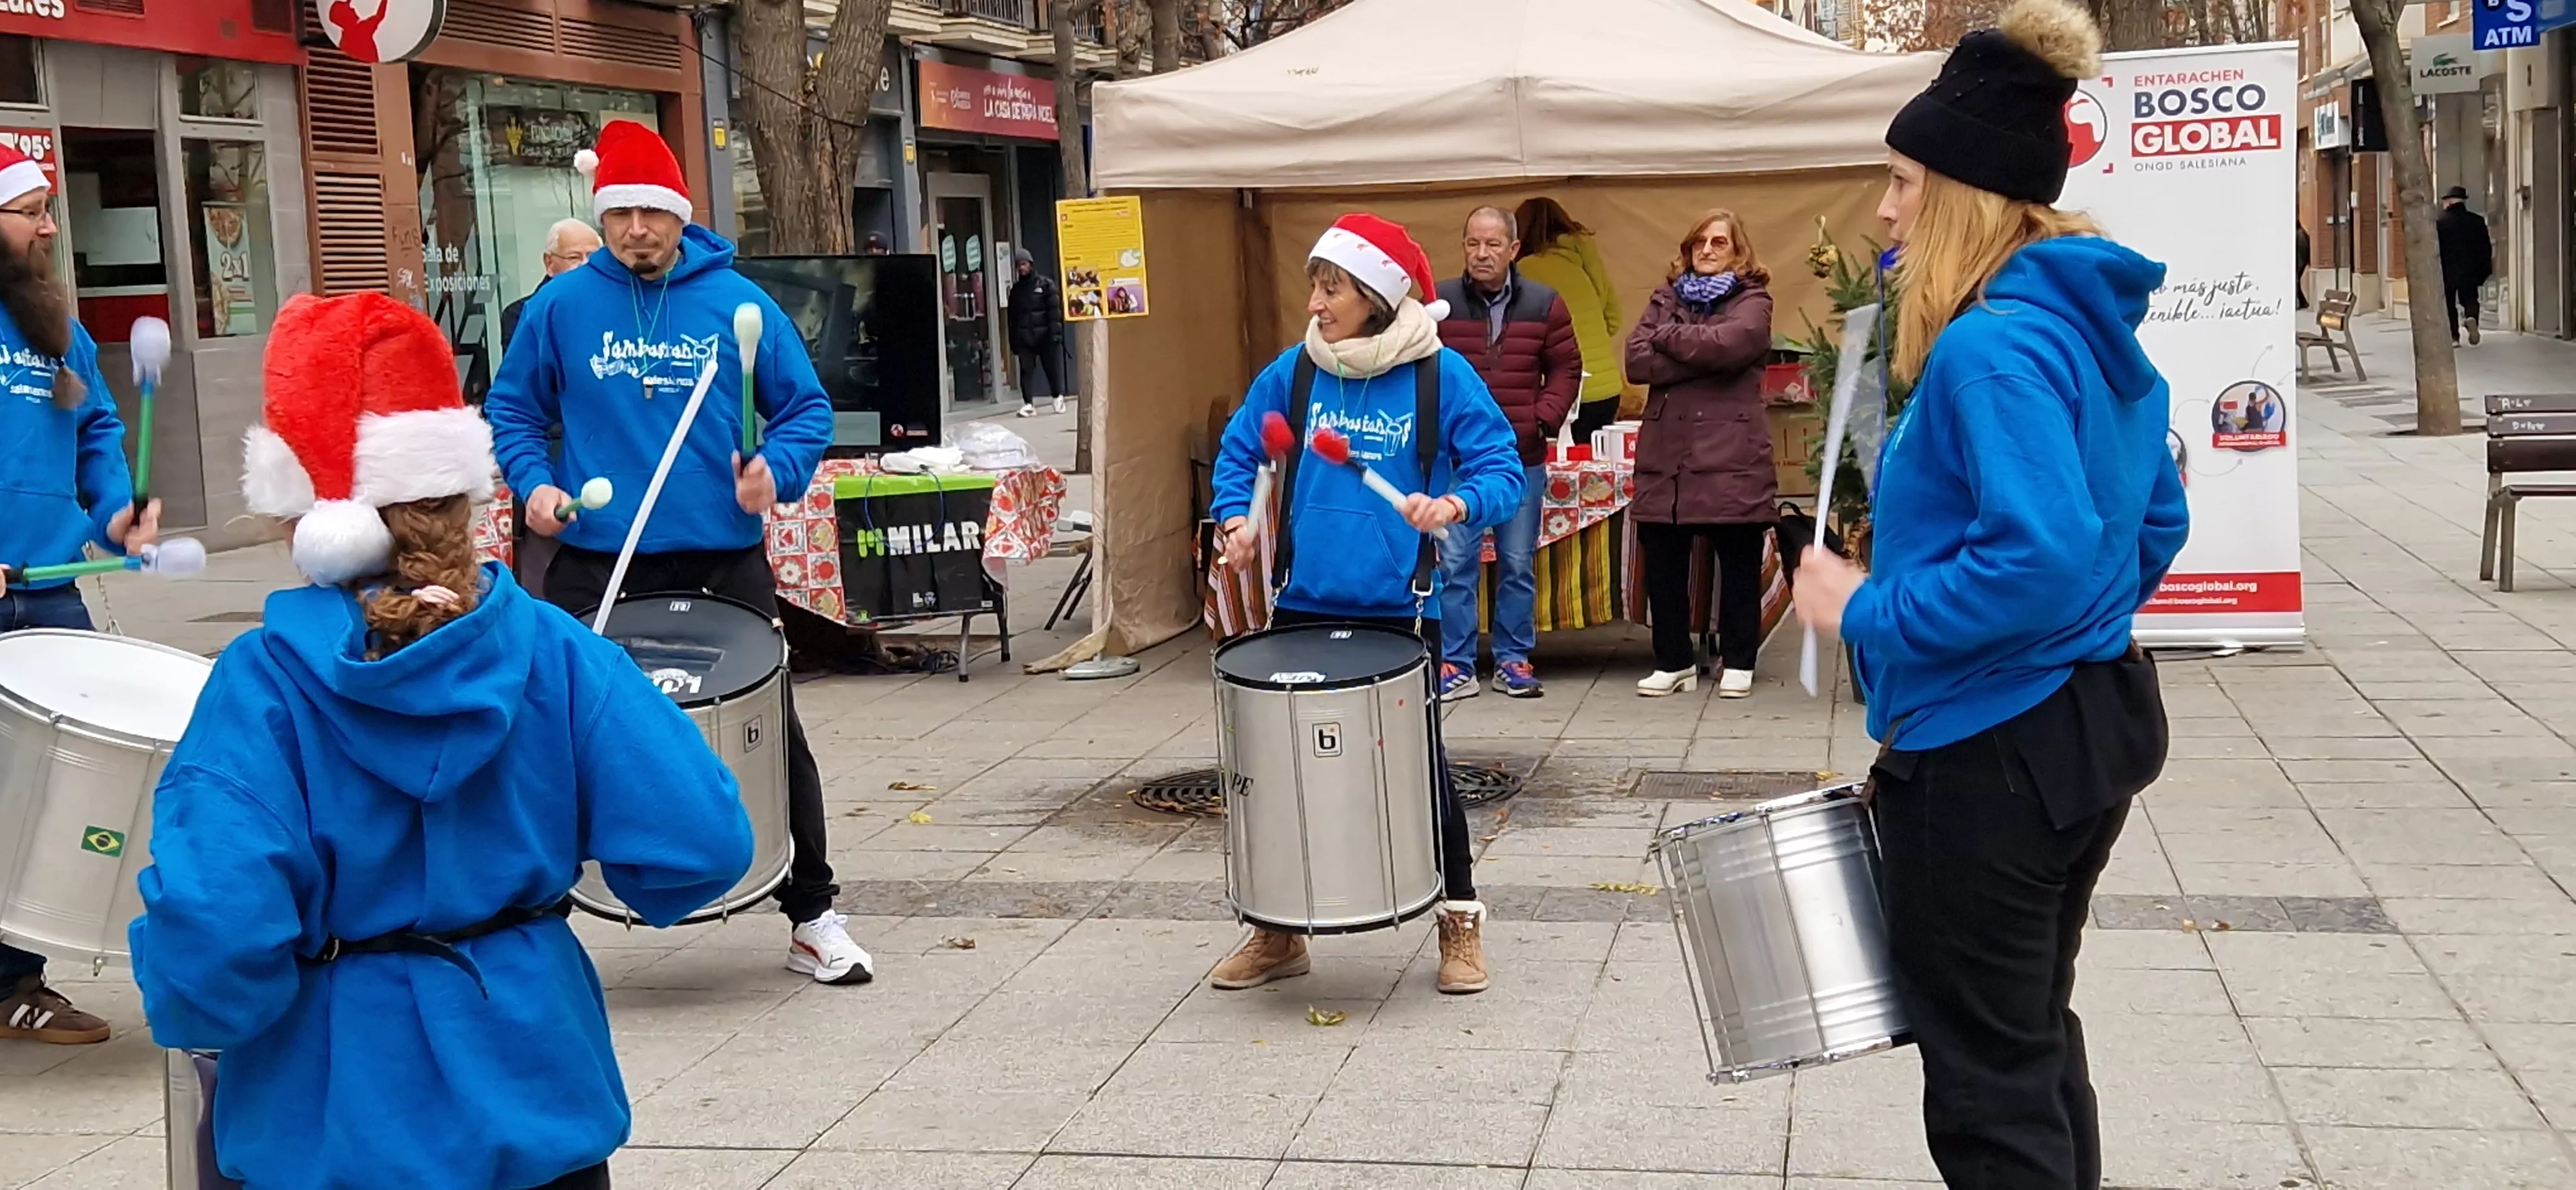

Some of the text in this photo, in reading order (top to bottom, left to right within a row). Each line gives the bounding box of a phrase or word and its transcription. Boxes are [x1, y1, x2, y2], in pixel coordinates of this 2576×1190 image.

[2484, 26, 2532, 46] ATM
[2134, 69, 2244, 87] ENTARACHEN
[2420, 66, 2472, 78] LACOSTE
[2134, 84, 2266, 118] BOSCO
[2134, 118, 2278, 154] GLOBAL
[2134, 157, 2246, 172] ONGD SALESIANA
[446, 241, 459, 263] de
[221, 252, 249, 281] 2x1
[887, 520, 981, 556] MILAR
[1318, 728, 1336, 750] b
